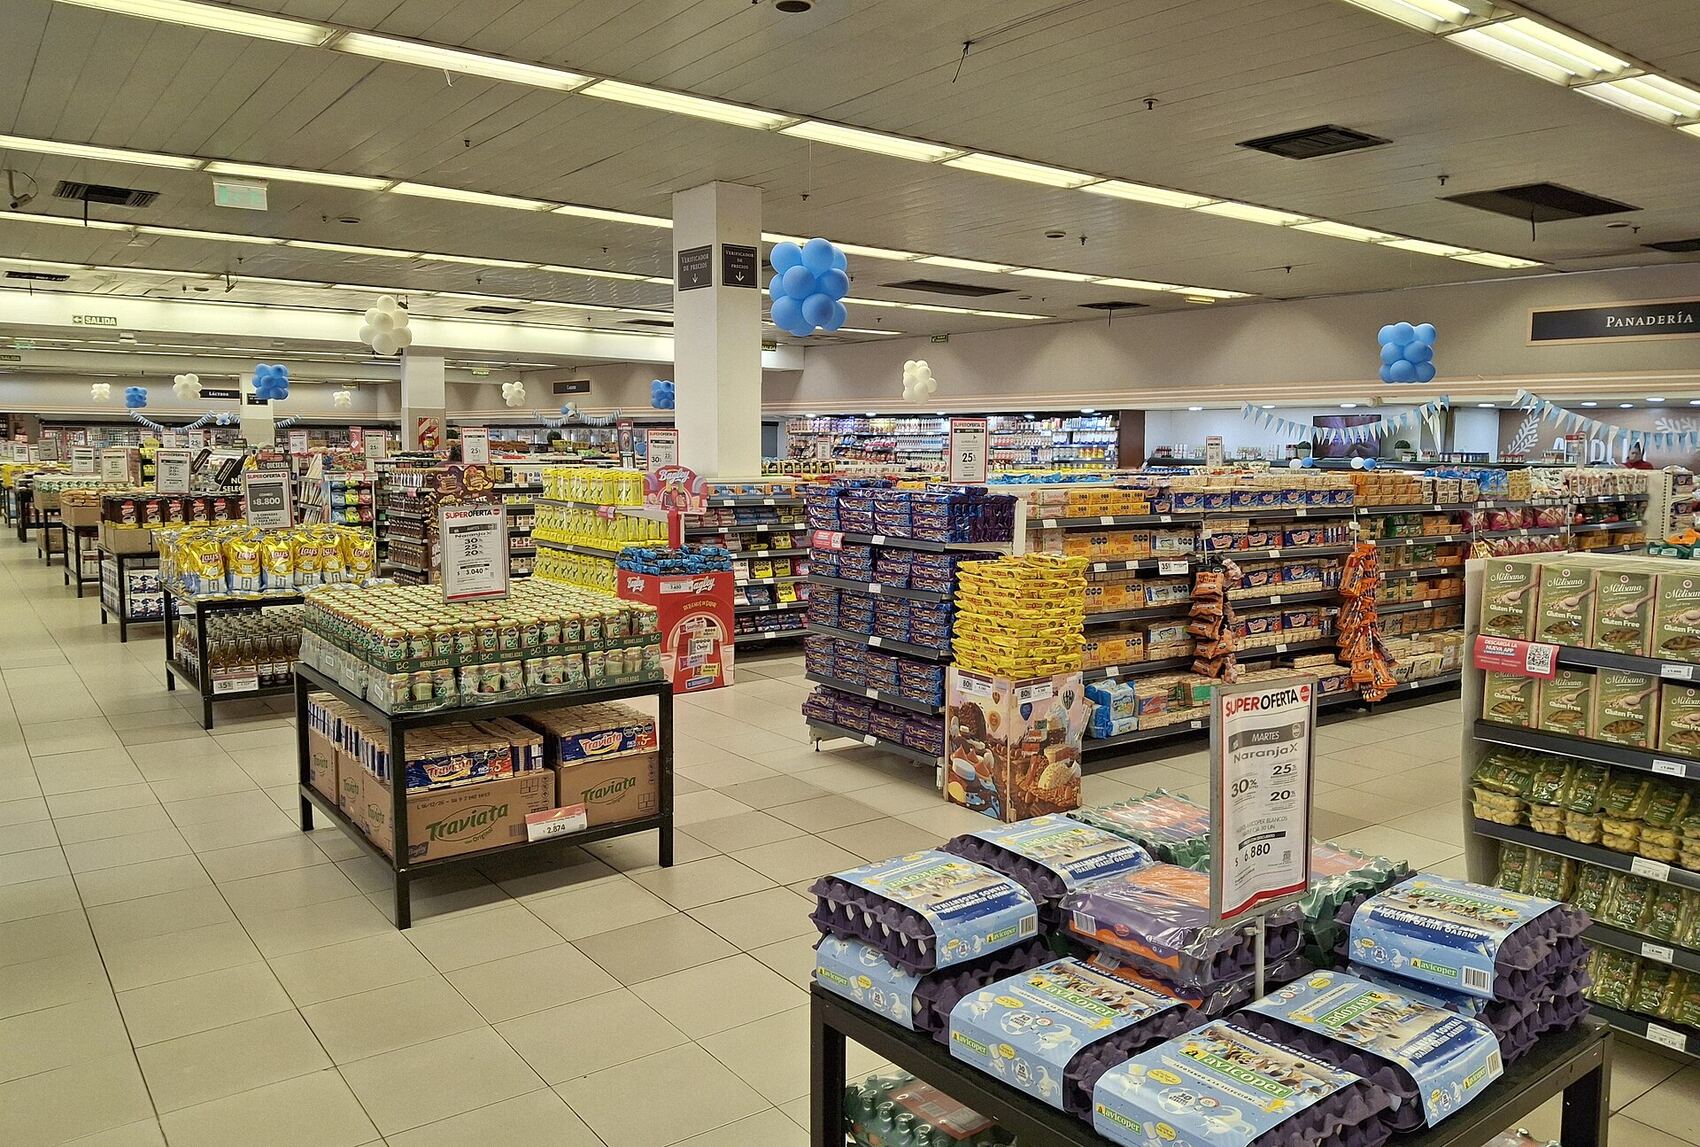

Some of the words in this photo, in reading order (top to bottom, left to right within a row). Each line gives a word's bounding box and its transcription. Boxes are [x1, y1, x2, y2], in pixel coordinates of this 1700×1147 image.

[681, 253, 709, 264] VERIFICADOR
[726, 250, 754, 258] VERIFICADOR
[690, 263, 708, 271] PRECIOS
[85, 316, 117, 325] SALIDA
[1606, 311, 1694, 329] PANADERÍA
[445, 509, 492, 519] SUPEROFERTA
[1490, 604, 1508, 613] Gluten
[1508, 606, 1524, 614] Free
[1546, 610, 1566, 620] Gluten
[1566, 612, 1582, 621] Free
[1601, 617, 1623, 627] Gluten
[1623, 620, 1640, 628] Free
[1663, 623, 1687, 633] Gluten
[547, 645, 558, 653] BC
[593, 642, 604, 650] BC
[607, 639, 618, 647] BC
[481, 653, 493, 661] BC
[531, 647, 542, 655] BC
[396, 661, 409, 671] BC
[460, 655, 472, 663] BC
[596, 678, 607, 687] BC
[1225, 688, 1299, 717] SUPEROFERTA
[1511, 694, 1525, 702] Free
[1566, 703, 1581, 712] Free
[1604, 708, 1626, 718] Gluten
[1626, 711, 1644, 720] Free
[1670, 720, 1689, 729] Gluten
[583, 732, 622, 752] Traviata
[1252, 731, 1280, 742] MARTES
[580, 776, 636, 803] Traviata
[425, 803, 509, 842] Traviata
[1244, 842, 1271, 861] 6.880
[1420, 961, 1457, 976] avicoper
[1048, 985, 1117, 1018] avicoper
[1324, 996, 1372, 1027] avicoper
[958, 1036, 988, 1055] avicoper
[1205, 1054, 1288, 1097] avicoper
[1104, 1108, 1141, 1133] avicoper
